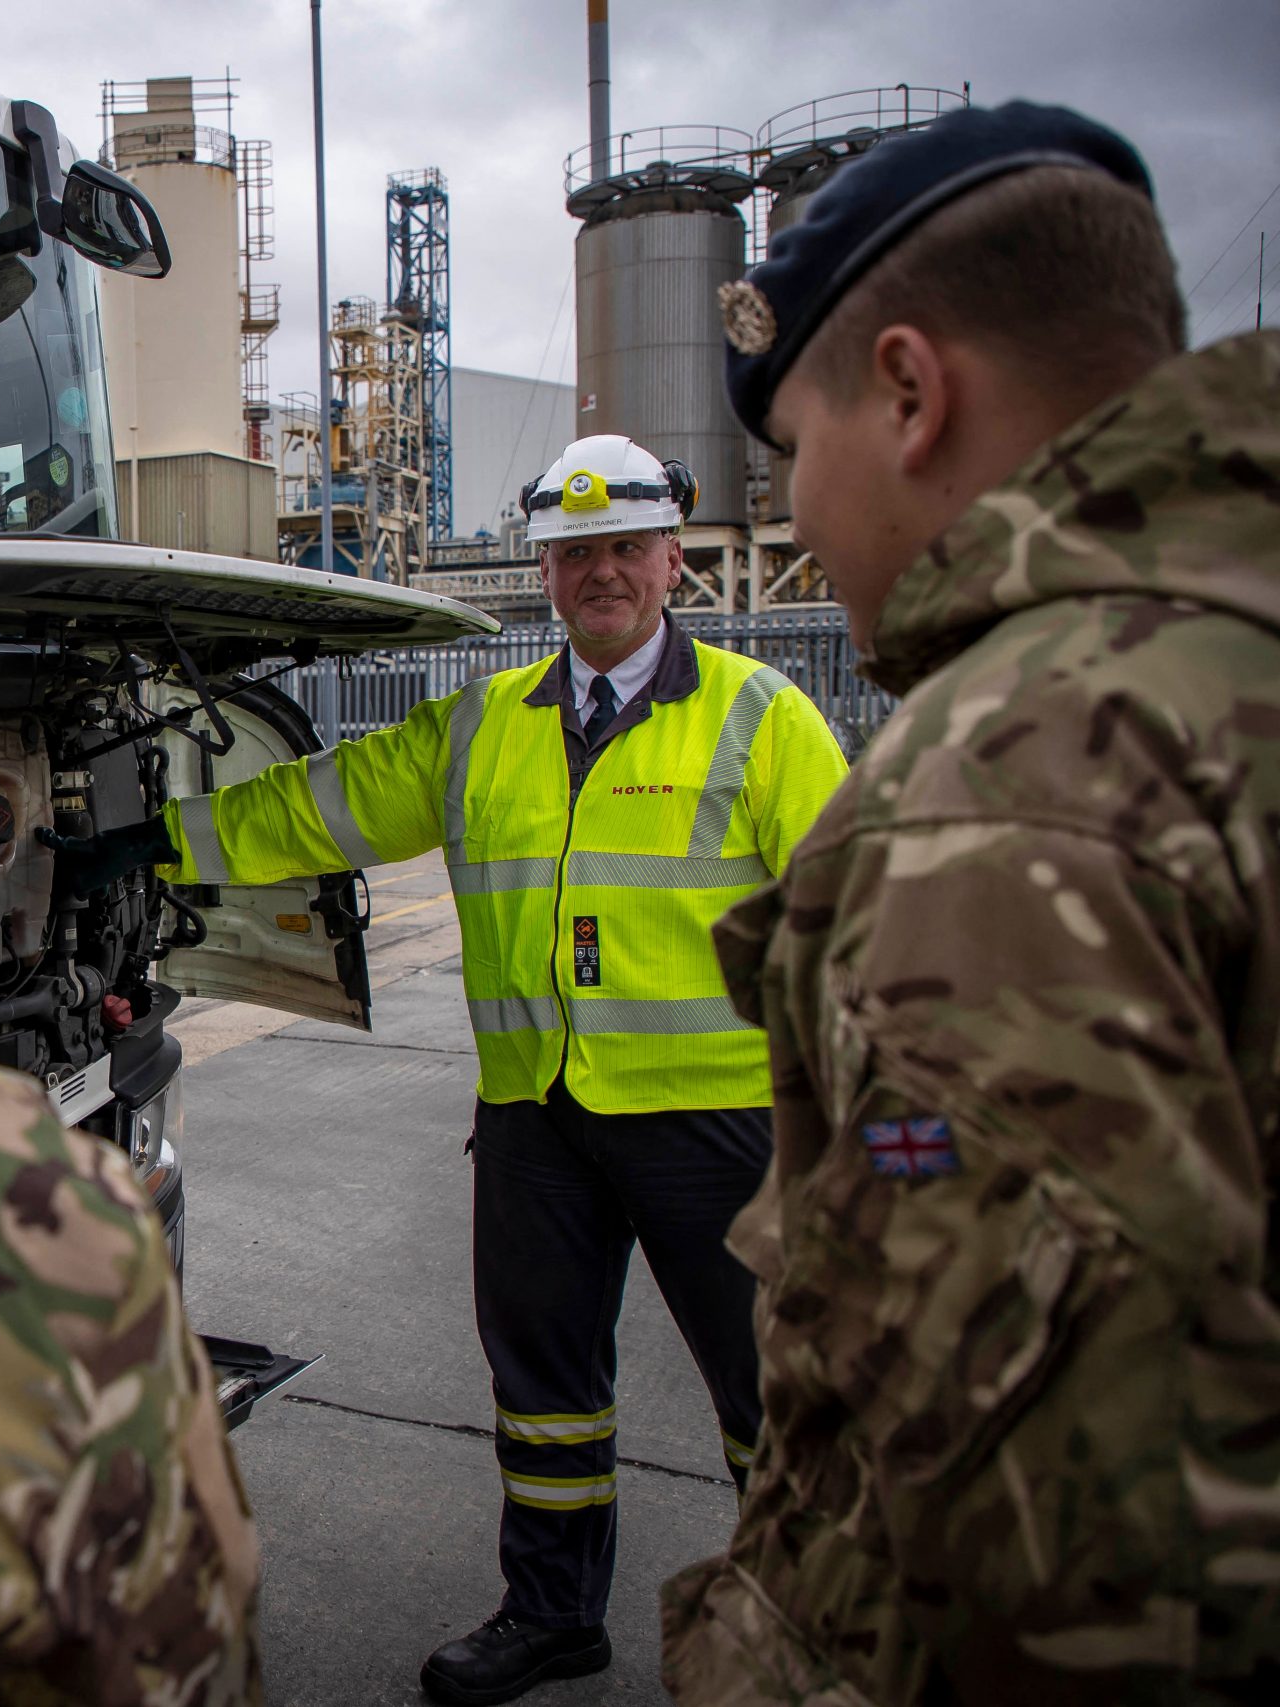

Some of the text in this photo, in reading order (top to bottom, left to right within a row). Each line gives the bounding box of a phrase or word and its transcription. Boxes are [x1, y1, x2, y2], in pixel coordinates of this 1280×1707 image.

[563, 519, 622, 531] DRIVER TRAINER
[612, 785, 674, 795] HOYER
